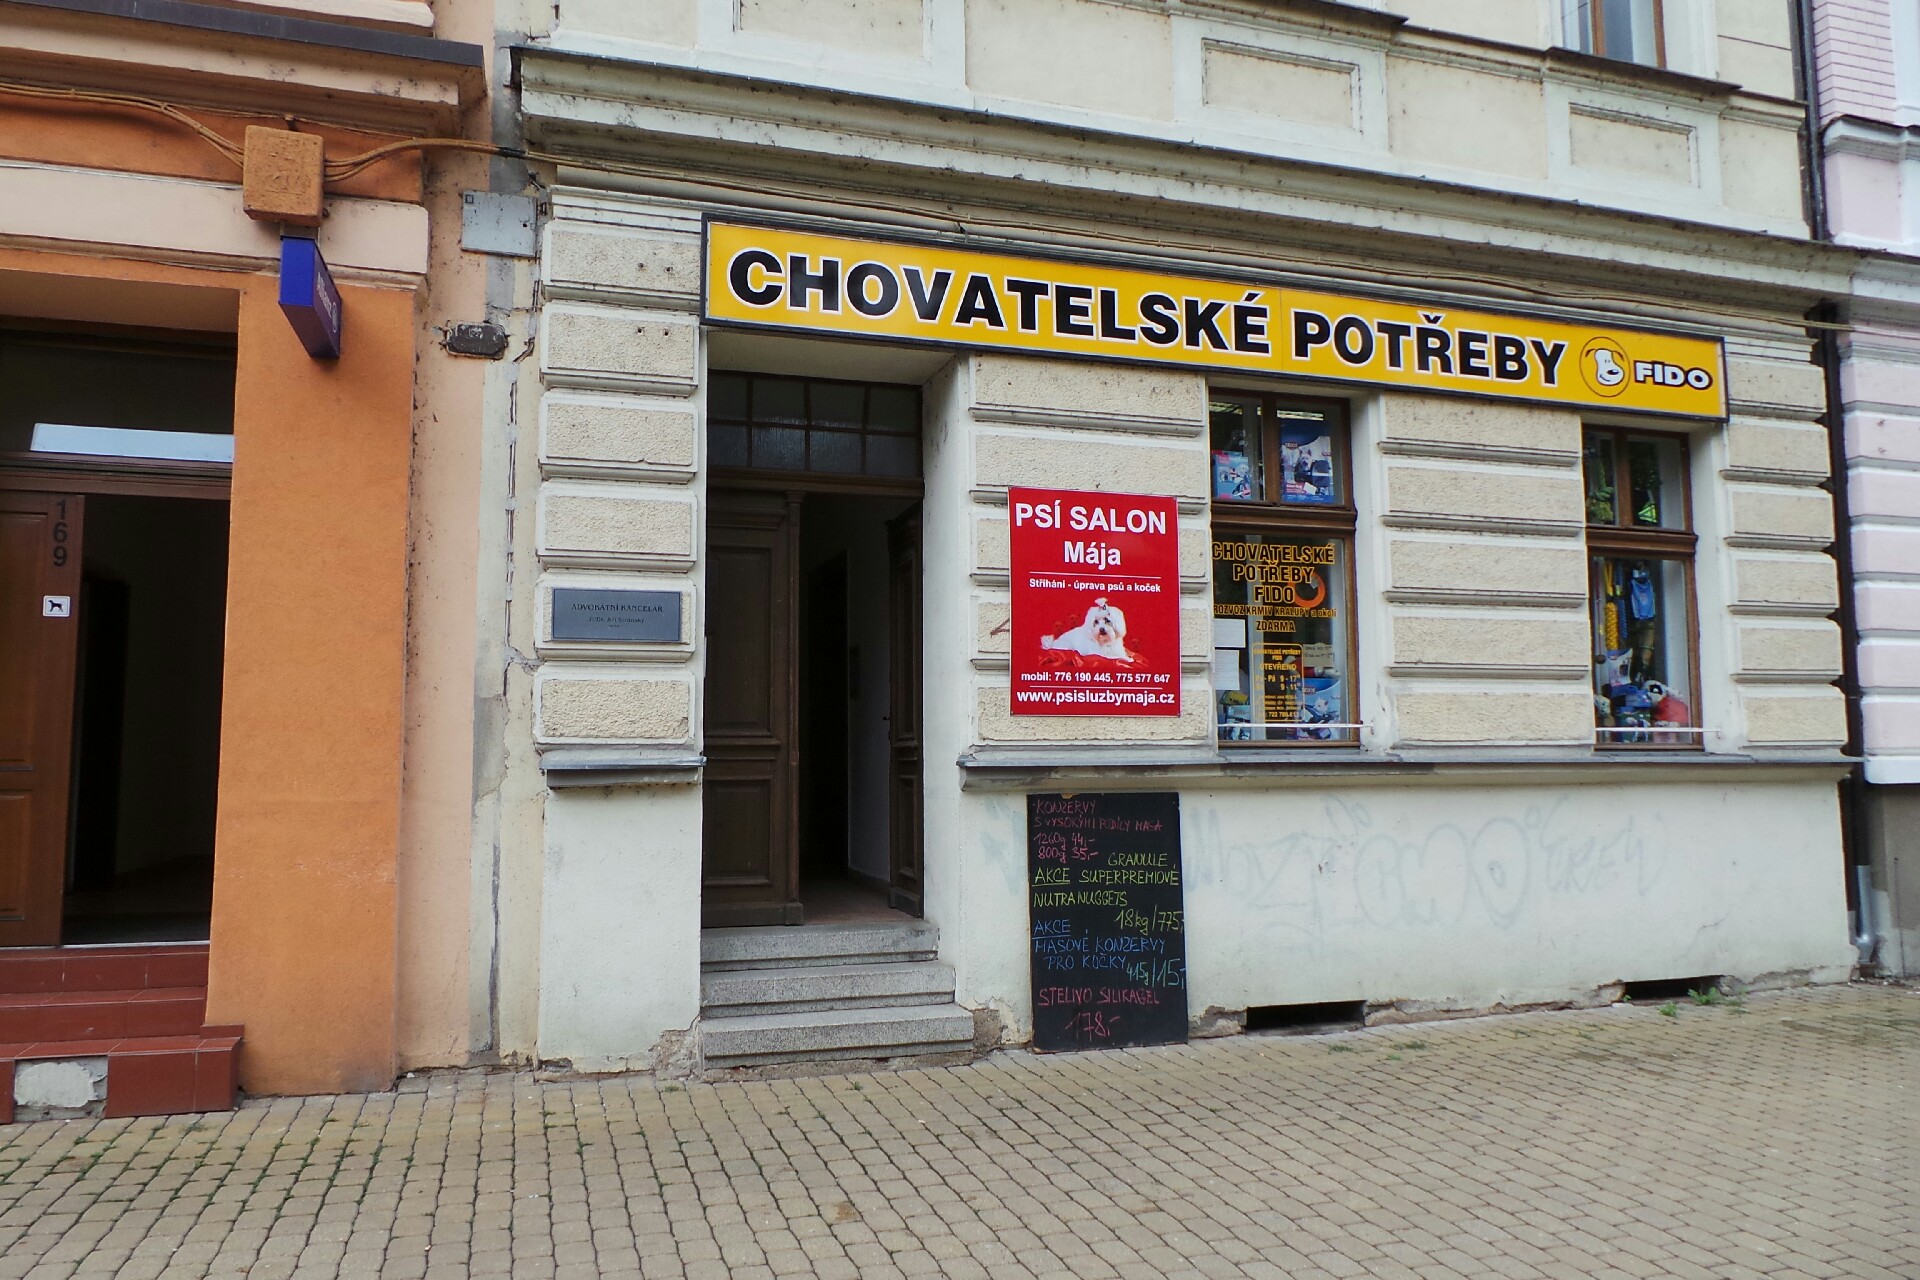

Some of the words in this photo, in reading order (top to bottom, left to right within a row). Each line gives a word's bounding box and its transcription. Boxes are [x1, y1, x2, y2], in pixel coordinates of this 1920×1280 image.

[728, 248, 1271, 357] CHOVATELSKÉ
[1292, 308, 1567, 388] POTŘEBY
[1635, 360, 1712, 390] FIDO
[1015, 500, 1061, 529] PSÍ
[1069, 505, 1166, 535] SALON
[1064, 541, 1121, 570] Mája
[1212, 541, 1336, 564] CHOVATELSKÉ
[1232, 559, 1315, 583] POTŘEBY
[1073, 580, 1105, 591] úprava
[1107, 582, 1124, 592] psů
[1134, 582, 1161, 593] koček
[1254, 585, 1296, 603] FIDO
[1214, 604, 1245, 615] ROZVOZ
[1246, 605, 1273, 617] KRMIV
[1274, 606, 1309, 617] KRALUPY
[1256, 620, 1296, 632] ZDARMA
[1021, 671, 1051, 682] mobil:
[1054, 672, 1072, 682] 776
[1074, 672, 1091, 682] 190
[1093, 672, 1113, 684] 445,
[1116, 673, 1132, 683] 775
[1135, 673, 1151, 683] 577
[1154, 674, 1170, 683] 647
[1016, 689, 1175, 706] www.psisluzbymaja.cz
[1036, 799, 1096, 814] KONZERVY
[1034, 832, 1067, 850] 1260g
[1038, 846, 1067, 864] 800g
[1108, 852, 1168, 867] GRANULE
[1034, 867, 1071, 884] AKCE
[1079, 864, 1179, 886] SUPERPREMIOVÉ
[1033, 891, 1075, 907] NUTRA
[1078, 890, 1128, 907] NUGGETS
[1034, 919, 1071, 936] AKCE
[1035, 929, 1089, 954] MASOVÉ
[1096, 936, 1165, 954] KONZERVY
[1043, 955, 1075, 971] PRO
[1082, 953, 1126, 970] KOČKY
[1038, 987, 1093, 1006] STELIVO
[1096, 986, 1160, 1005] SILIKAGEL
